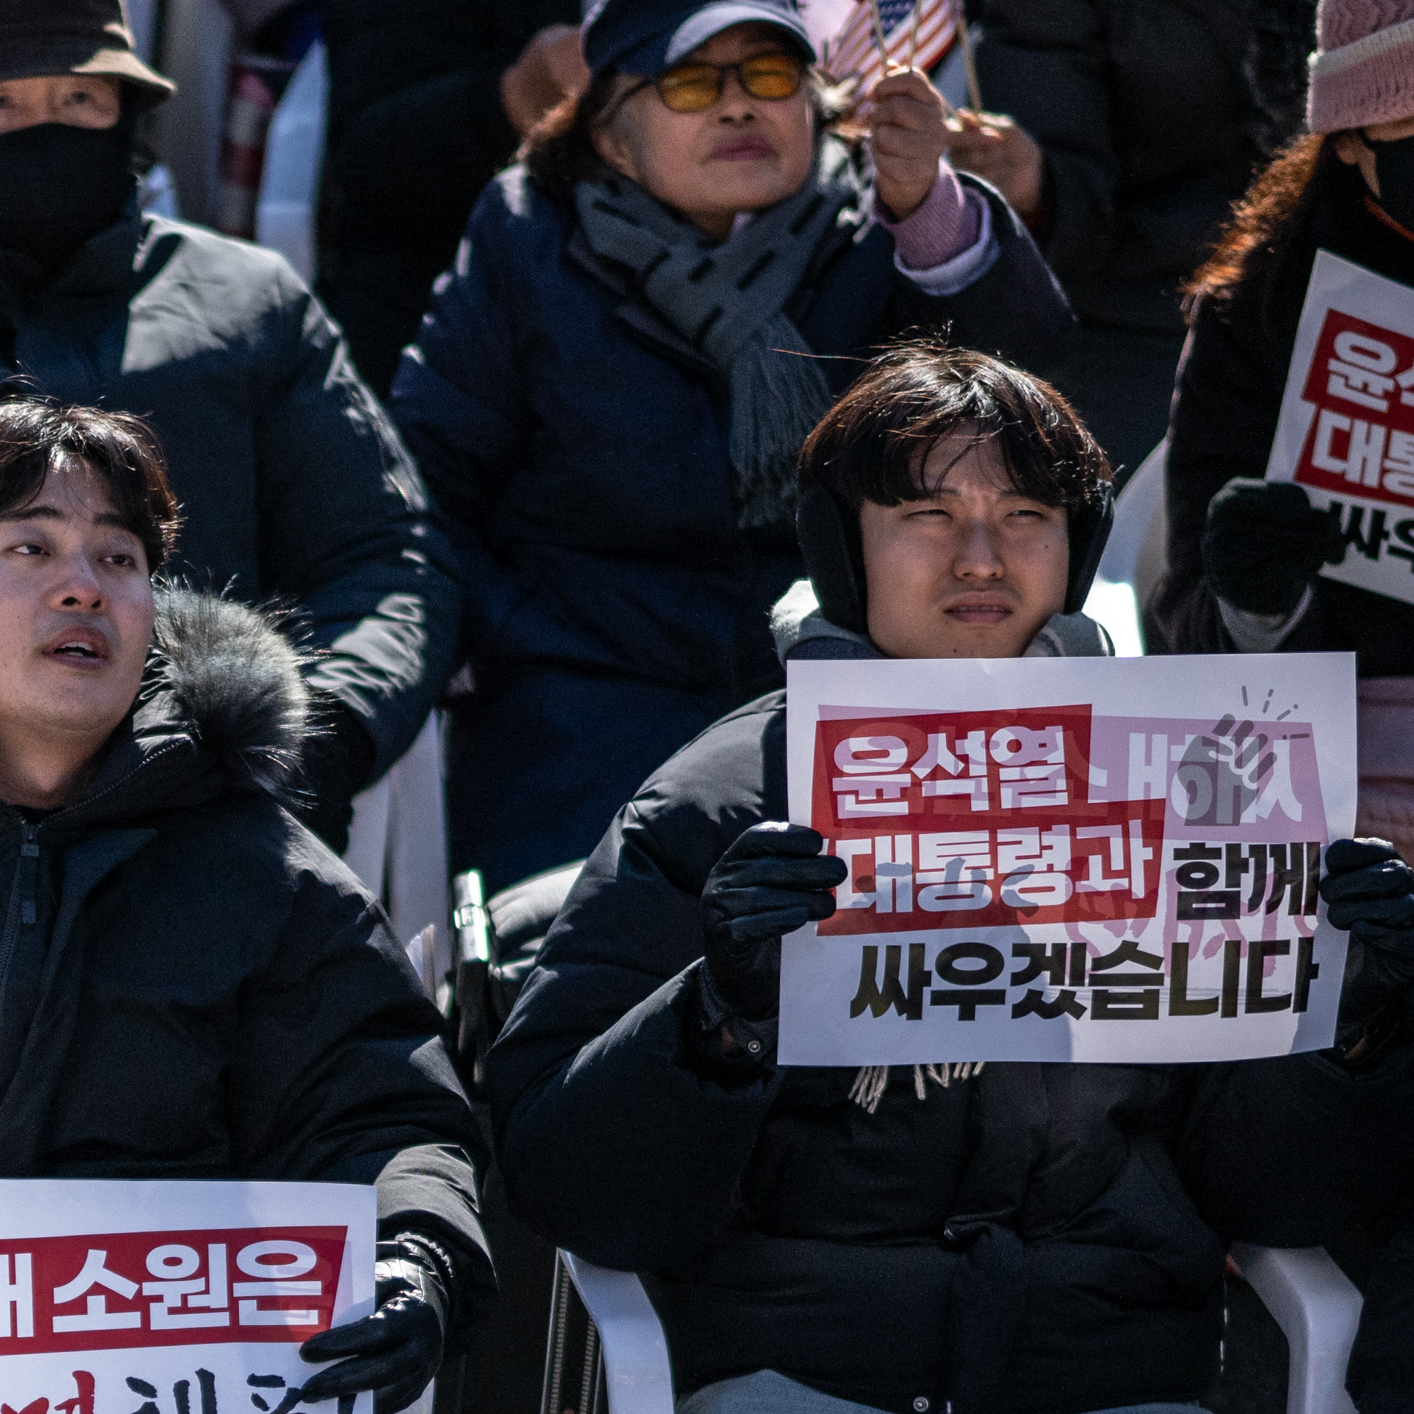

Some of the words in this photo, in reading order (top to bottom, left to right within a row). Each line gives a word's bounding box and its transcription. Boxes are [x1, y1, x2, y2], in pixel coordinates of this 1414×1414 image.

[1327, 330, 1414, 413] 윤
[832, 726, 1068, 818] 윤석열
[835, 819, 1153, 914] 대통령과
[1173, 841, 1321, 921] 함께
[850, 936, 1320, 1021] 싸우겠습니다
[52, 1239, 322, 1334] 소원은
